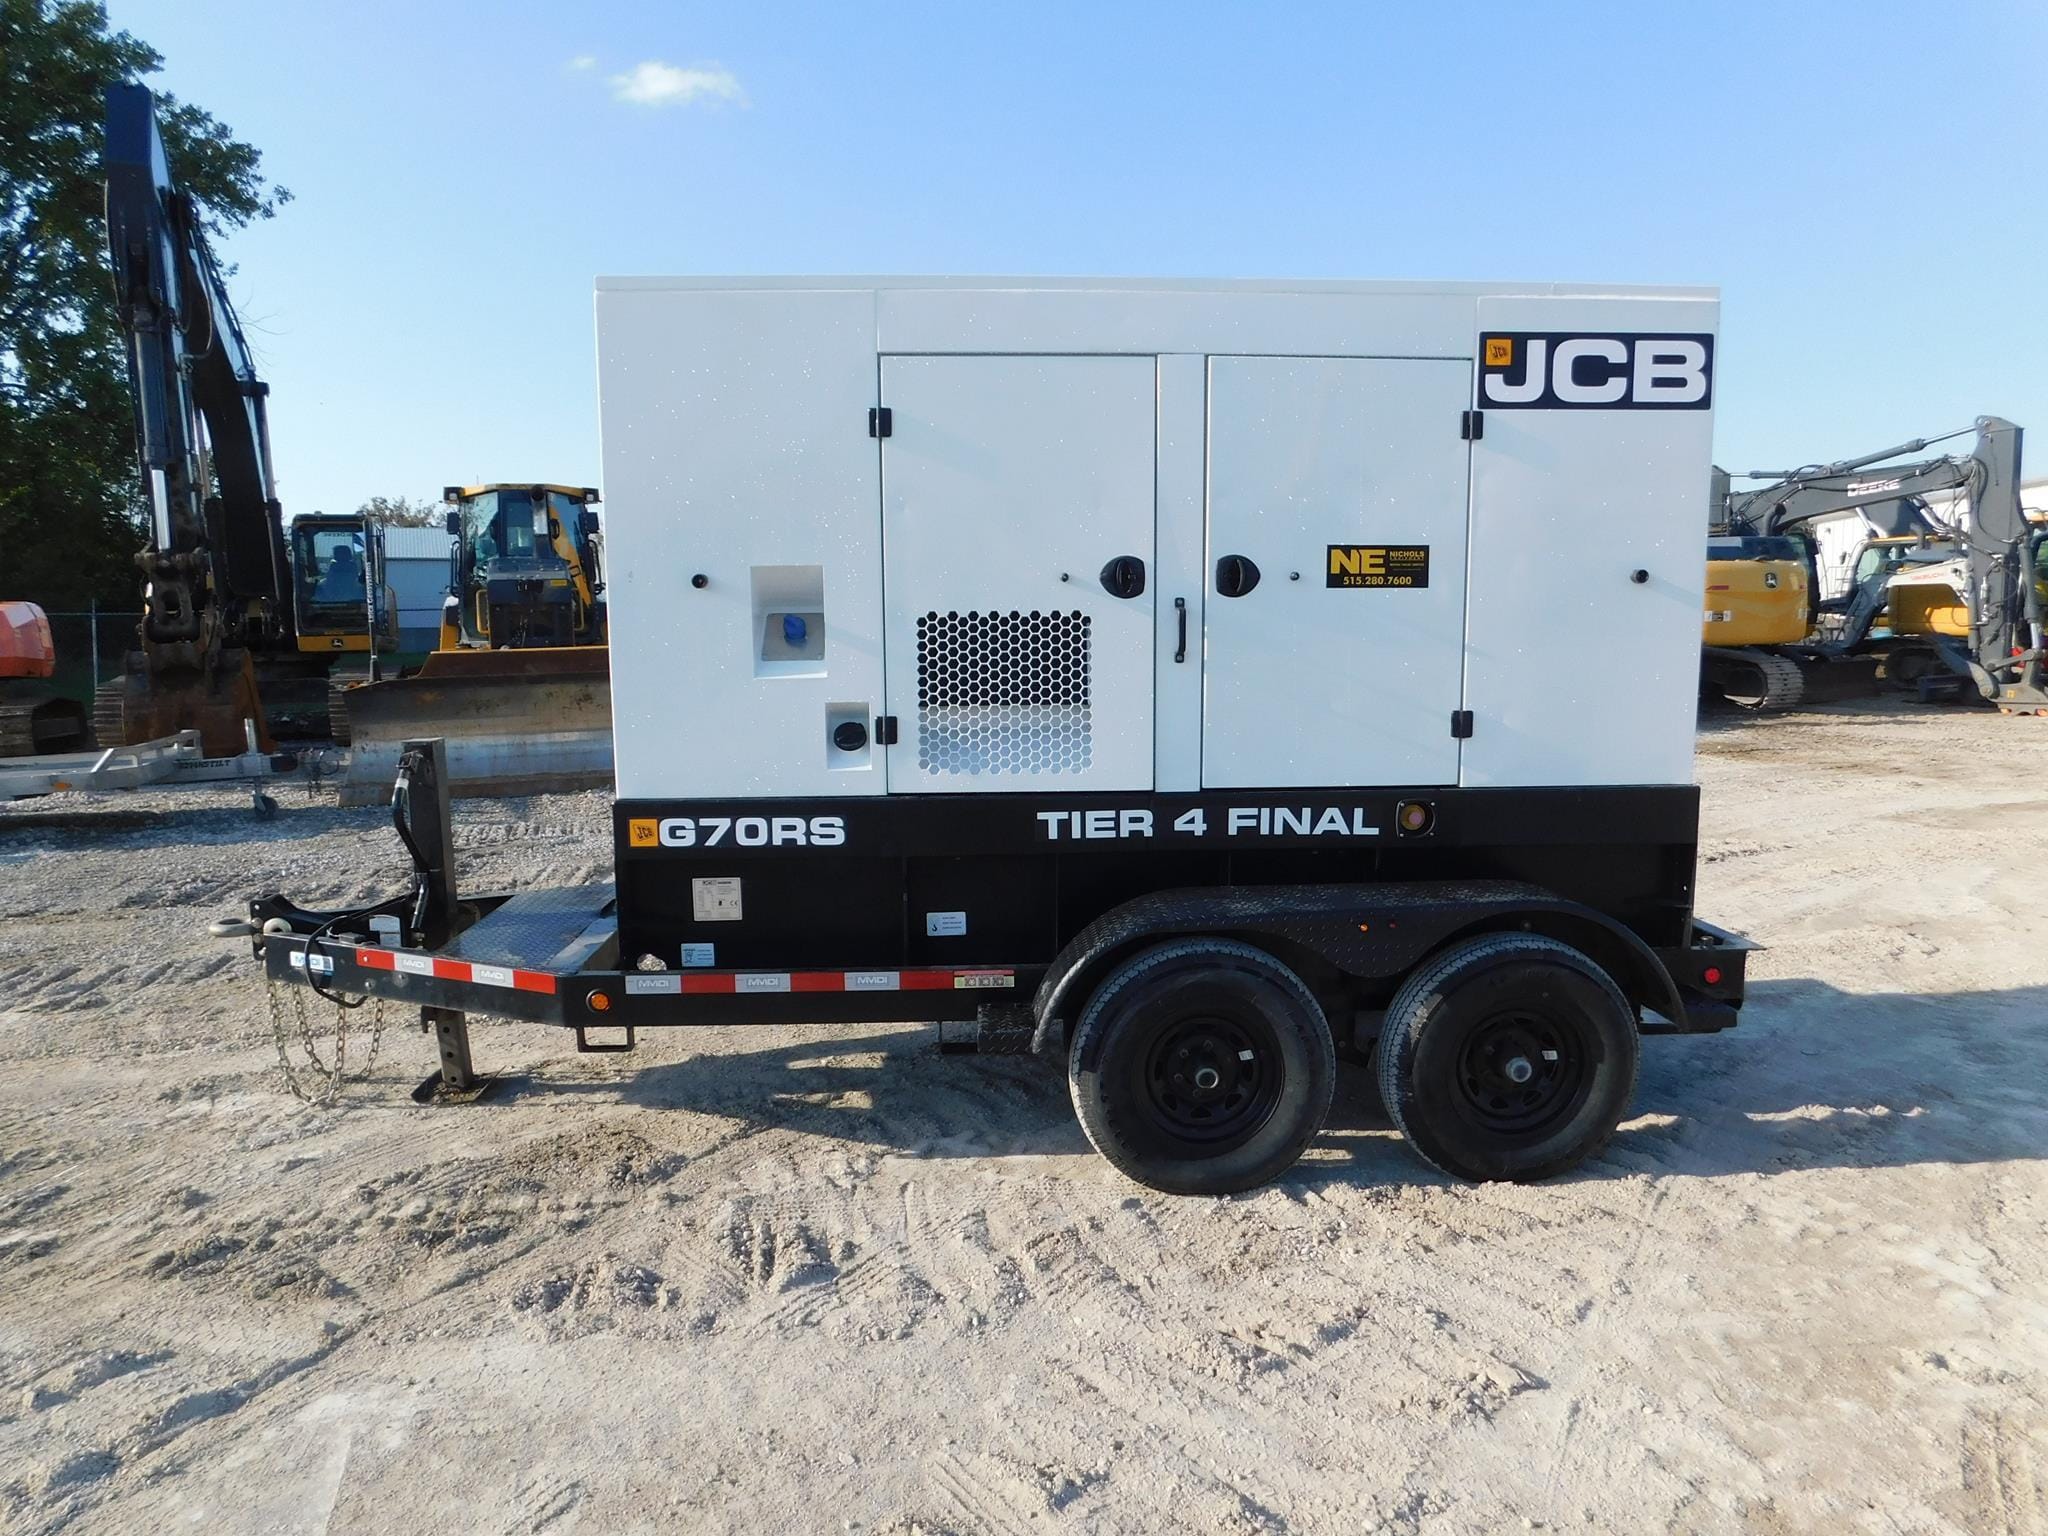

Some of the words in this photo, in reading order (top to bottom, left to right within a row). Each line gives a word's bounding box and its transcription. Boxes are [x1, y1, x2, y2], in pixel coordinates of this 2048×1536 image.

[1485, 339, 1706, 402] JCB
[1847, 479, 1900, 497] DEERE
[1331, 549, 1386, 574] NE
[366, 562, 374, 603] Geosystems
[1343, 576, 1412, 585] 515.280.7600
[659, 817, 845, 847] G70RS
[1036, 809, 1154, 839] TIER
[1173, 808, 1207, 836] 4
[1228, 808, 1379, 835] FINAL
